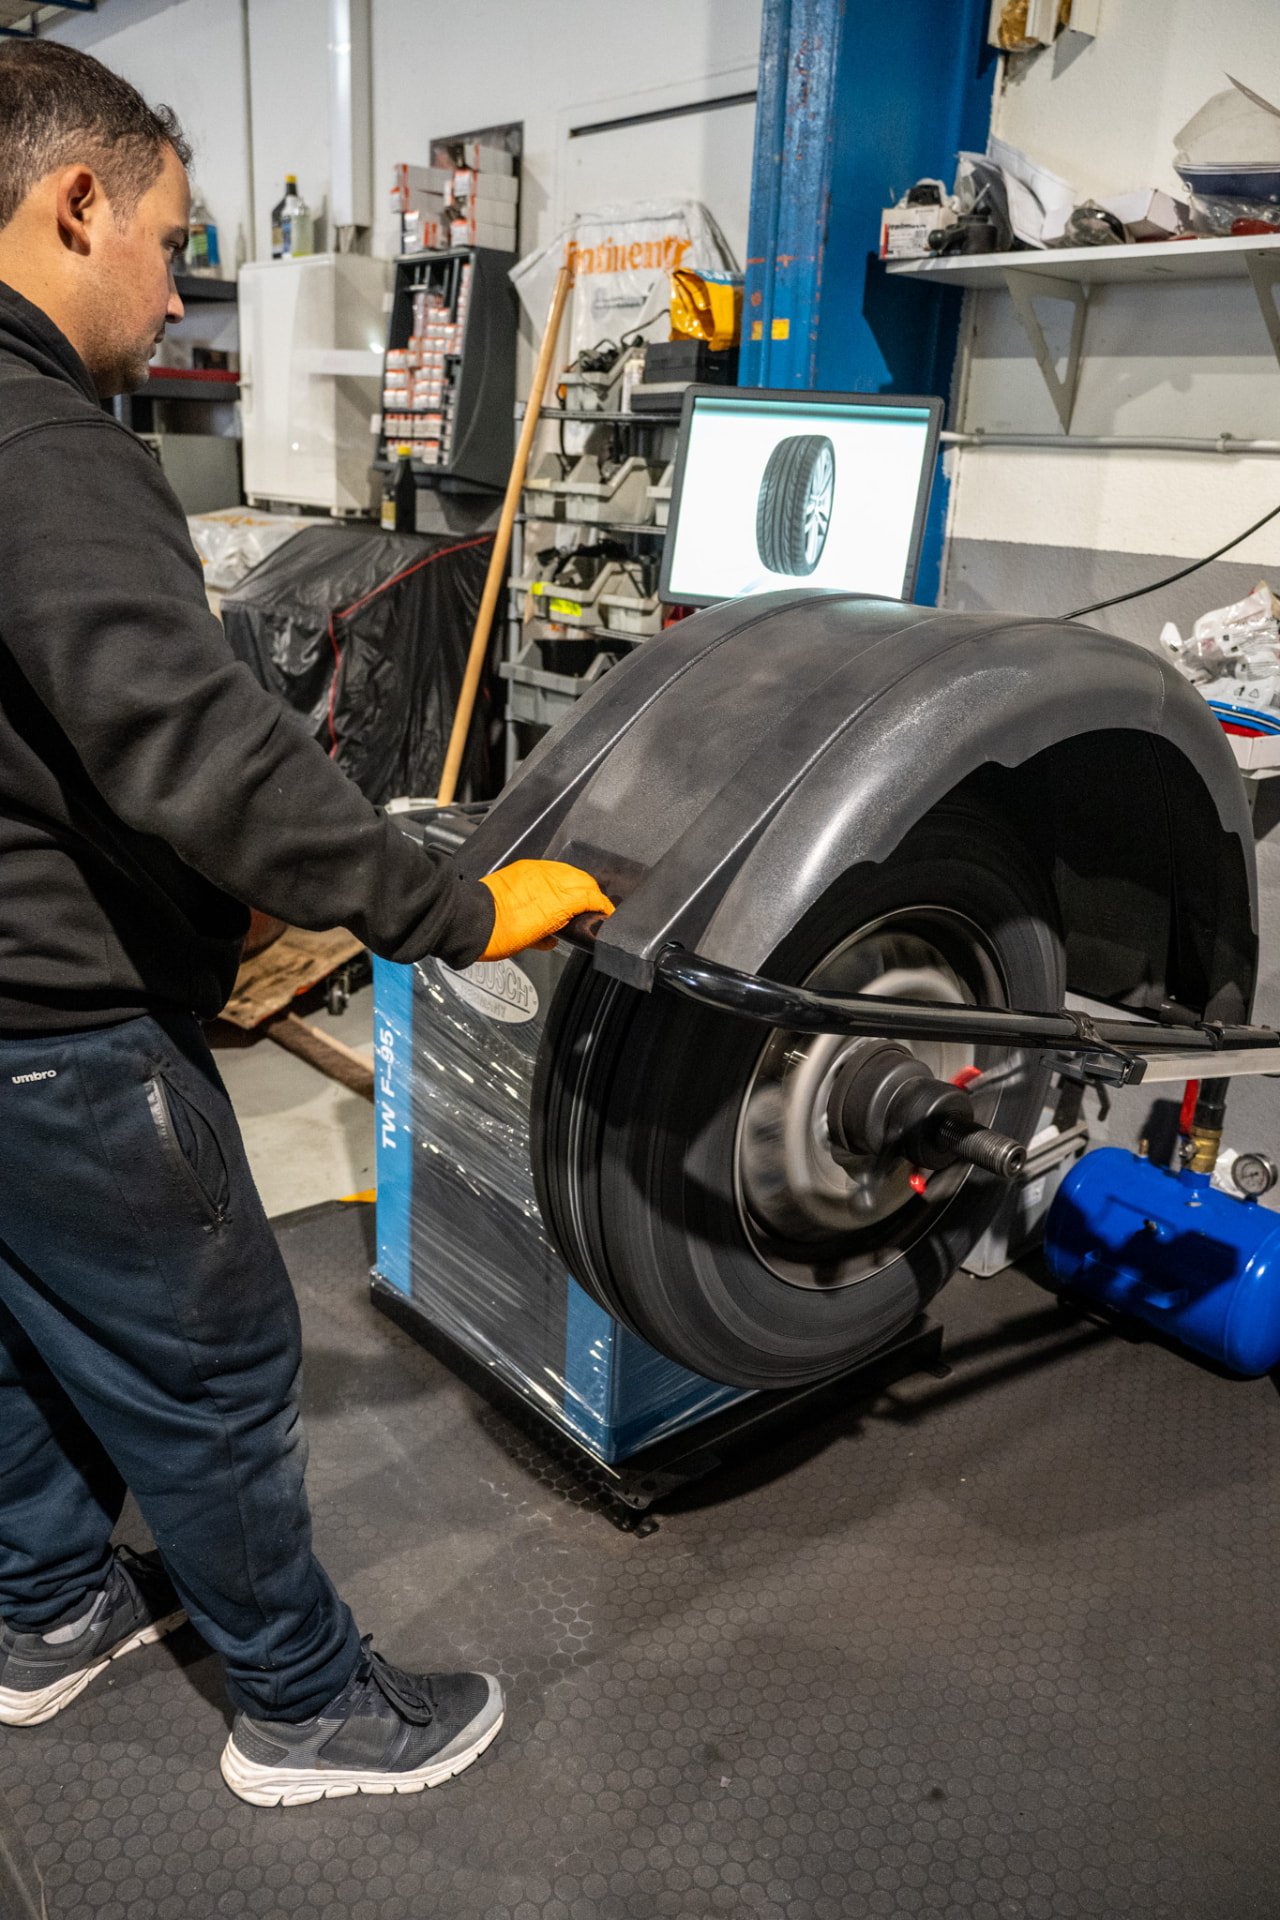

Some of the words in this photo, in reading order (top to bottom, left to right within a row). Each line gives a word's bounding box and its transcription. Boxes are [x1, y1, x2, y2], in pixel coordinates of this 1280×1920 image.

[11, 1069, 57, 1084] umbro
[380, 1028, 396, 1098] F-95
[381, 1101, 397, 1149] TW
